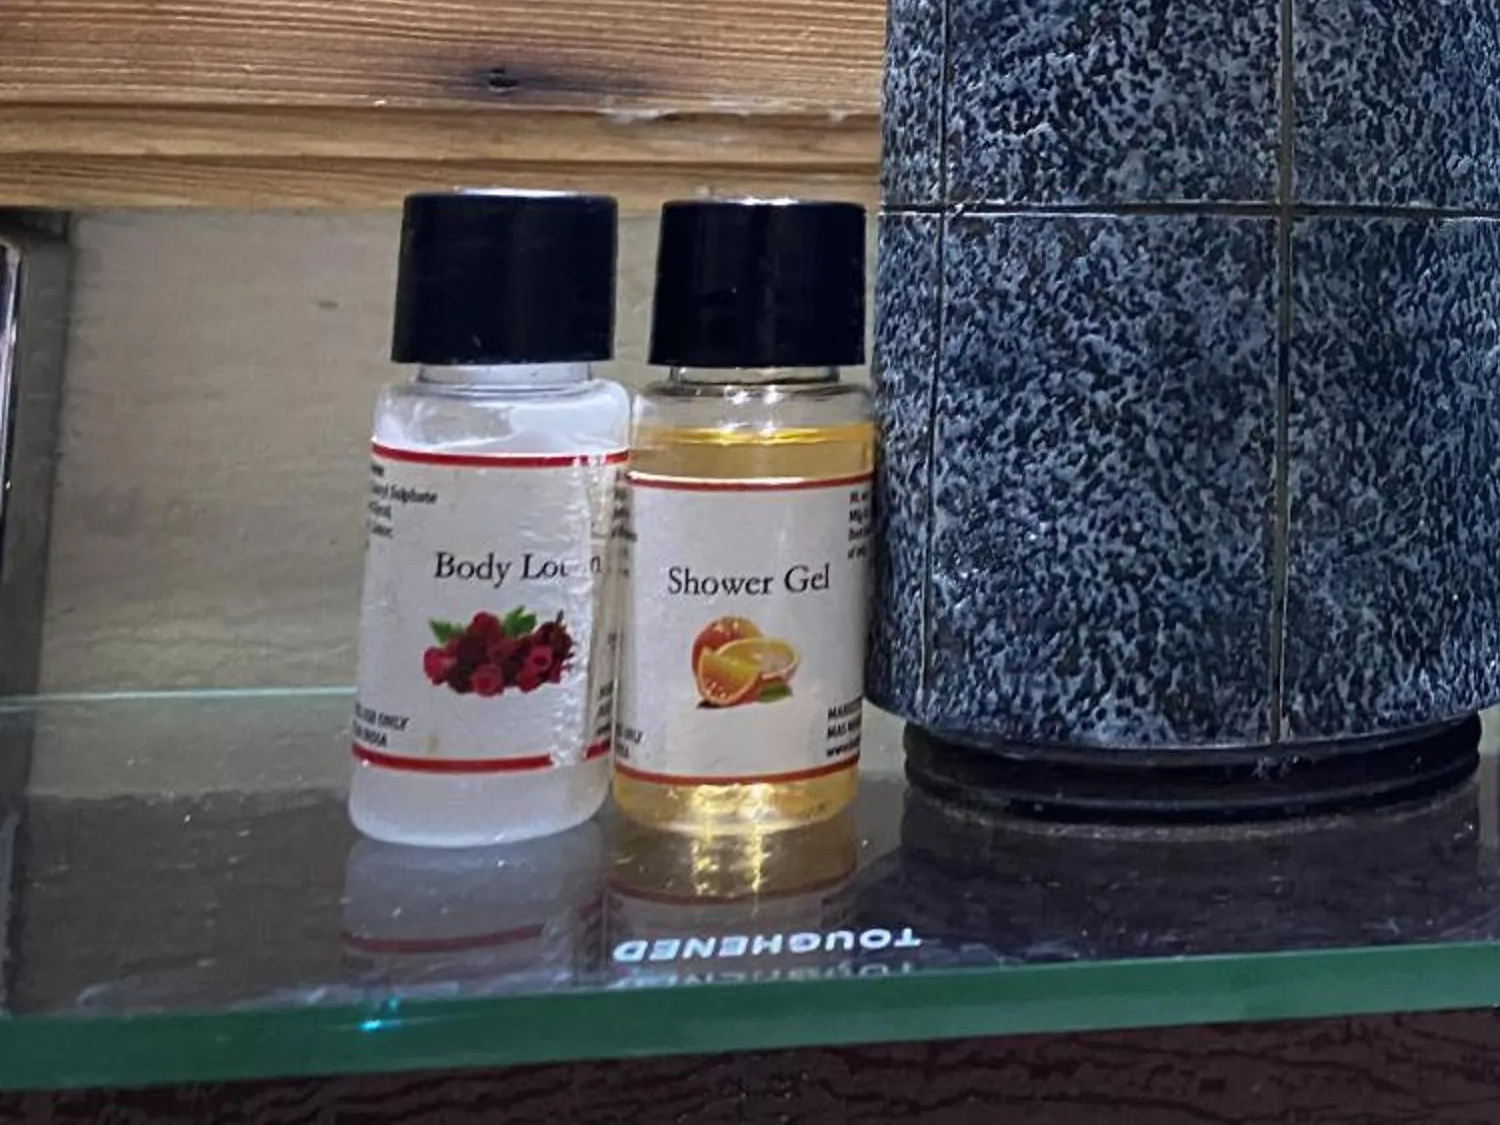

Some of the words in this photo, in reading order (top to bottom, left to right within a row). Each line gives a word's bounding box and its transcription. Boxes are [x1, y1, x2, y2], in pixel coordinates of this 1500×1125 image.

[434, 551, 512, 587] Body
[667, 565, 774, 596] Shower
[784, 563, 830, 594] Gel
[613, 927, 922, 962] TOUGHENED
